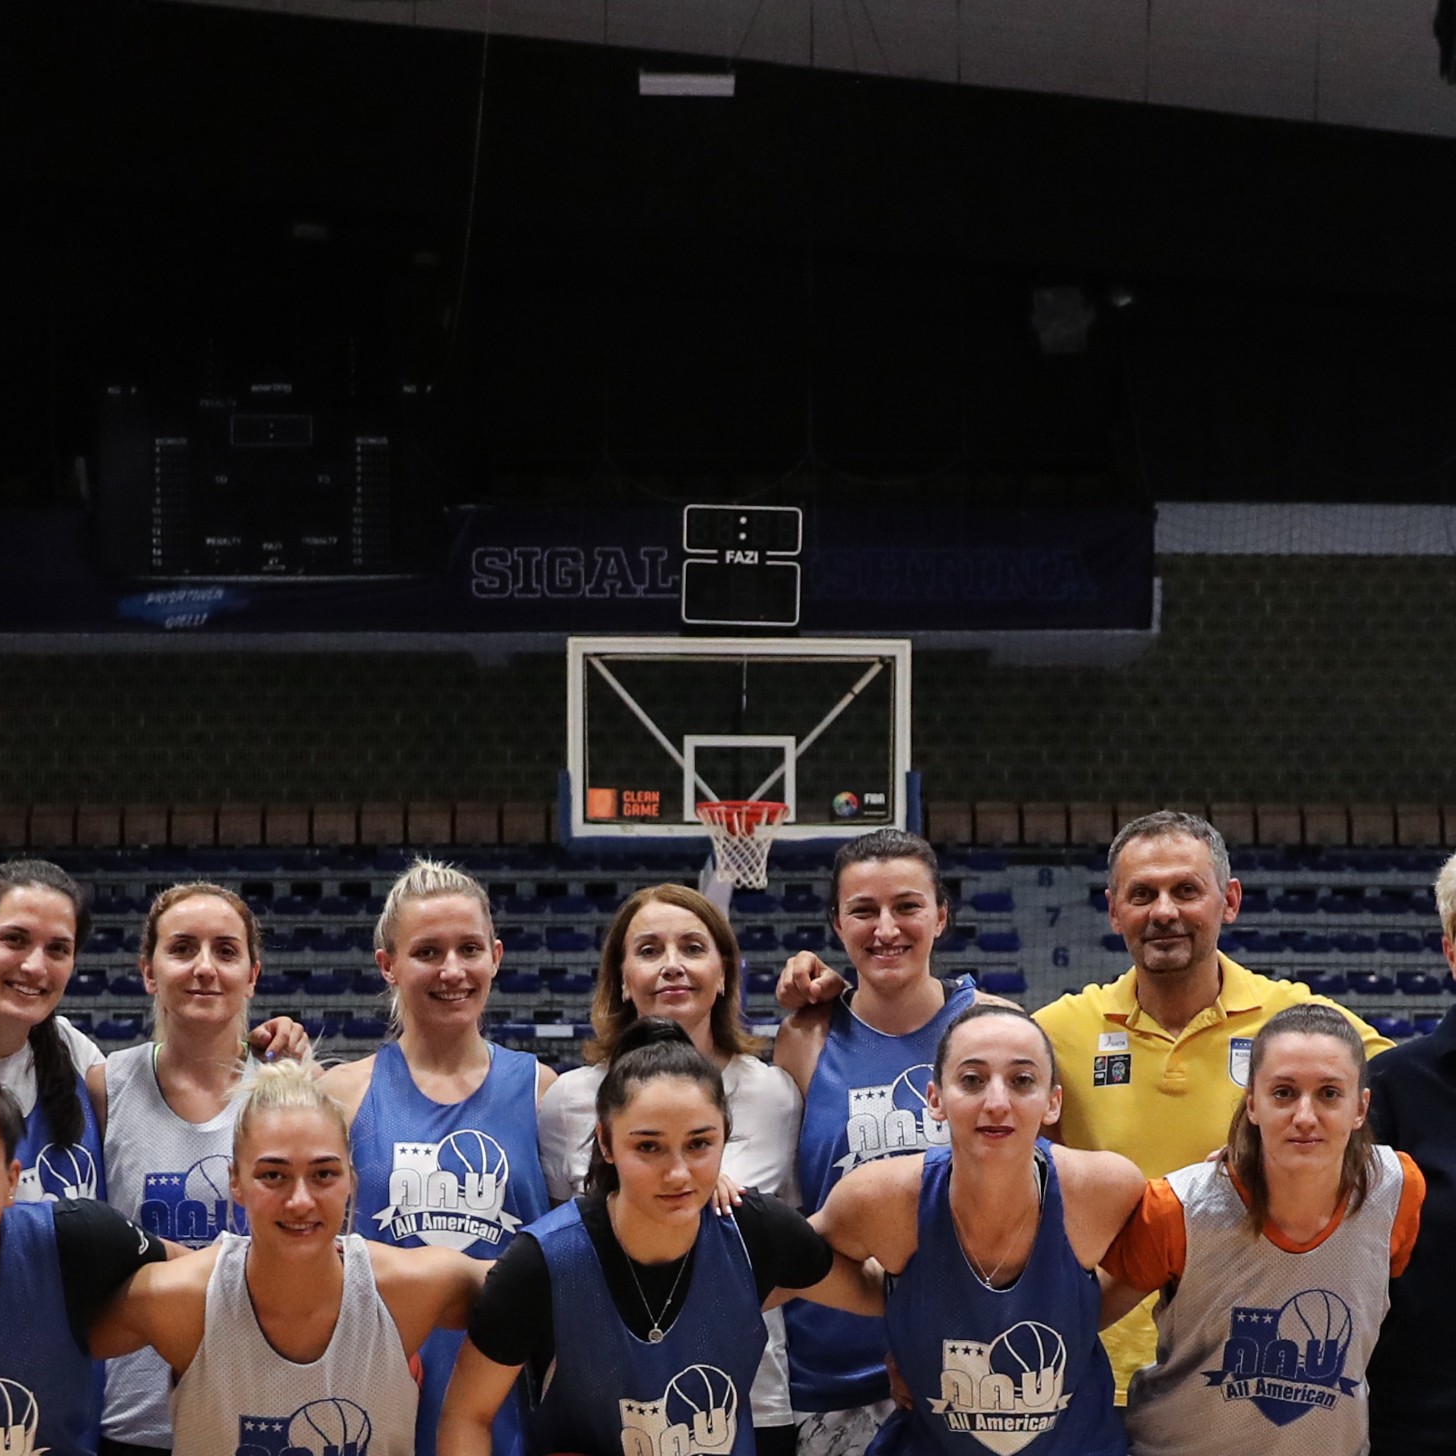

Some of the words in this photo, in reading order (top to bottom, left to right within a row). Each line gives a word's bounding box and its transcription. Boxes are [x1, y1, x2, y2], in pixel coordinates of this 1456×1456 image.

[725, 551, 758, 564] FAZI
[472, 547, 681, 599] SIGAL
[623, 790, 660, 803] CLEAN
[623, 803, 660, 816] GAME
[396, 1213, 417, 1237] All
[421, 1212, 500, 1242] American
[1226, 1382, 1250, 1399] All
[1255, 1378, 1337, 1407] American
[948, 1412, 971, 1430] All
[975, 1413, 1057, 1432] American
